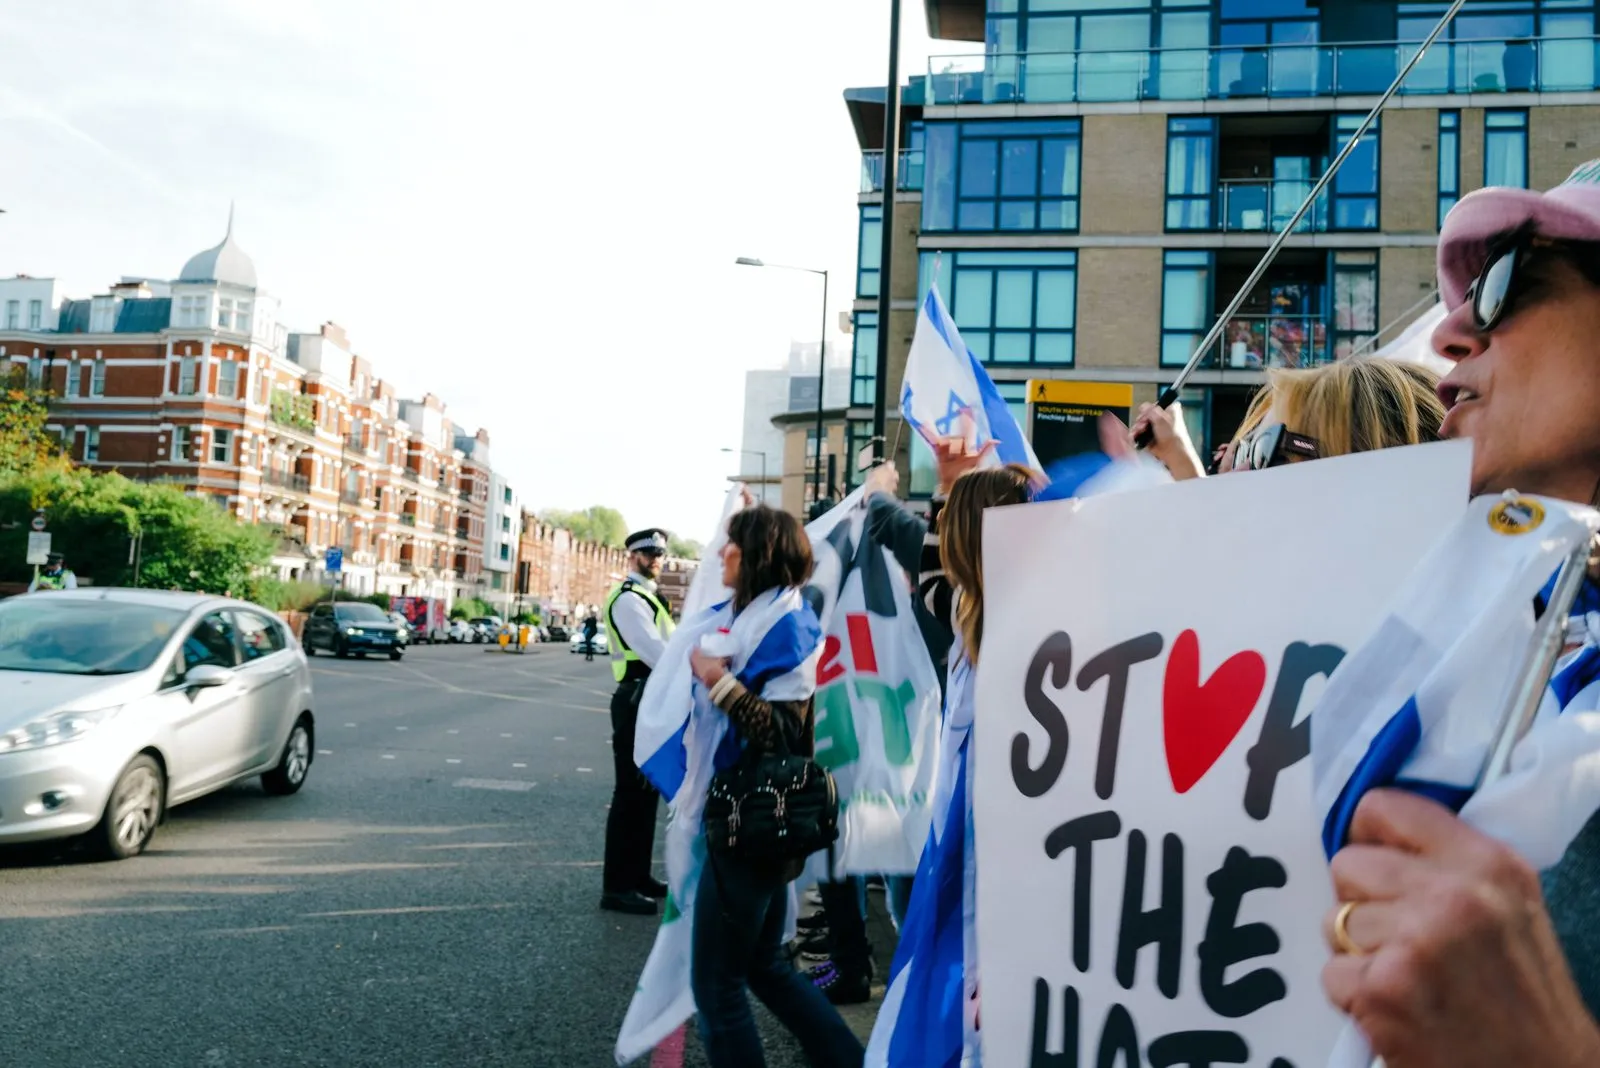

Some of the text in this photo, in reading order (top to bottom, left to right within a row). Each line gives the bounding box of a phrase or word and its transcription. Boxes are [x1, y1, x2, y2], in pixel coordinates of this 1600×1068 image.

[1038, 406, 1061, 414] SOUTH
[1037, 413, 1084, 422] Finchley Road
[1044, 810, 1287, 1018] THE
